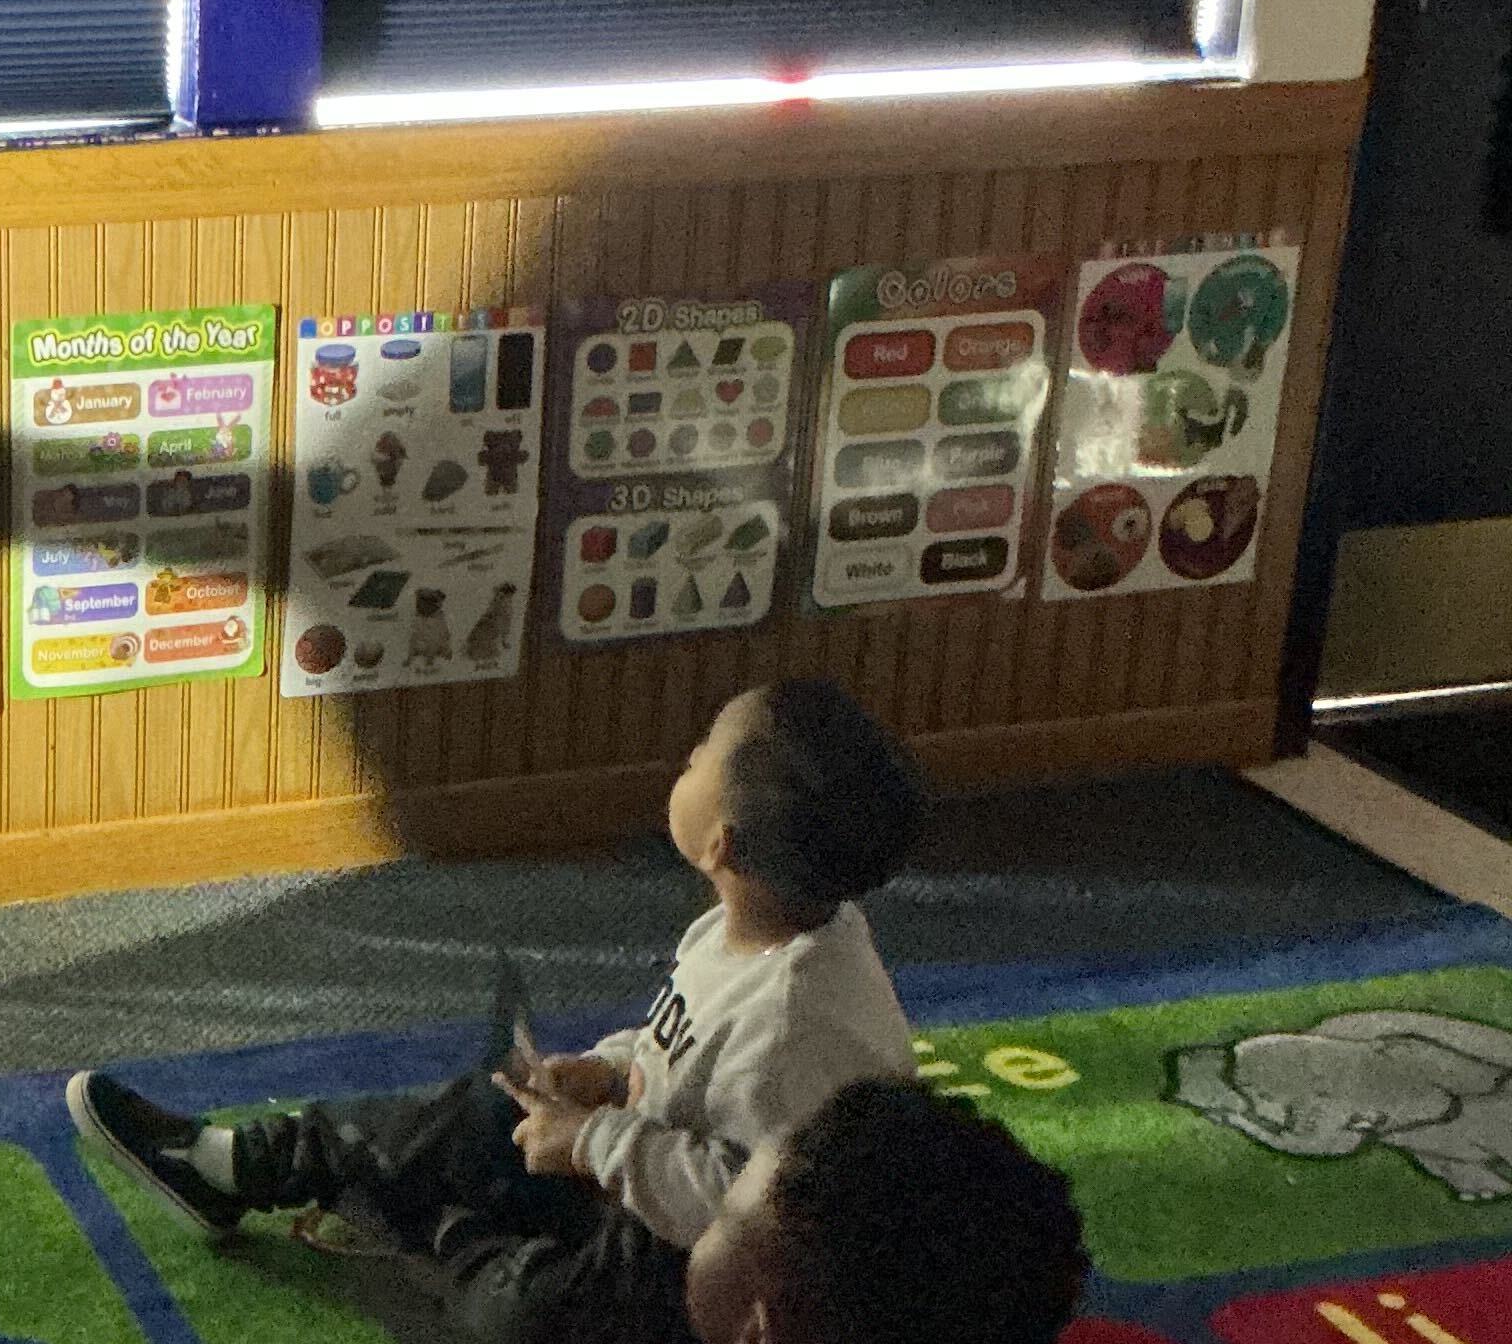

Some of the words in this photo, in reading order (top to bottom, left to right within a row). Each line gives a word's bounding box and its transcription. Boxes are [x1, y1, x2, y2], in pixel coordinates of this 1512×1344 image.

[877, 265, 1018, 308] Colors
[620, 306, 664, 334] 2D
[674, 303, 759, 330] Shapes
[33, 330, 124, 362] Months
[130, 325, 156, 355] of
[162, 324, 202, 354] the
[205, 320, 258, 349] Year
[76, 395, 133, 411] January
[186, 386, 247, 402] February
[325, 411, 341, 421] full
[159, 437, 192, 455] April
[610, 485, 652, 511] 3D
[41, 550, 72, 565] July
[846, 562, 894, 579] White
[65, 594, 136, 613] September
[186, 583, 240, 599] October
[38, 646, 105, 662] November
[149, 635, 215, 651] December
